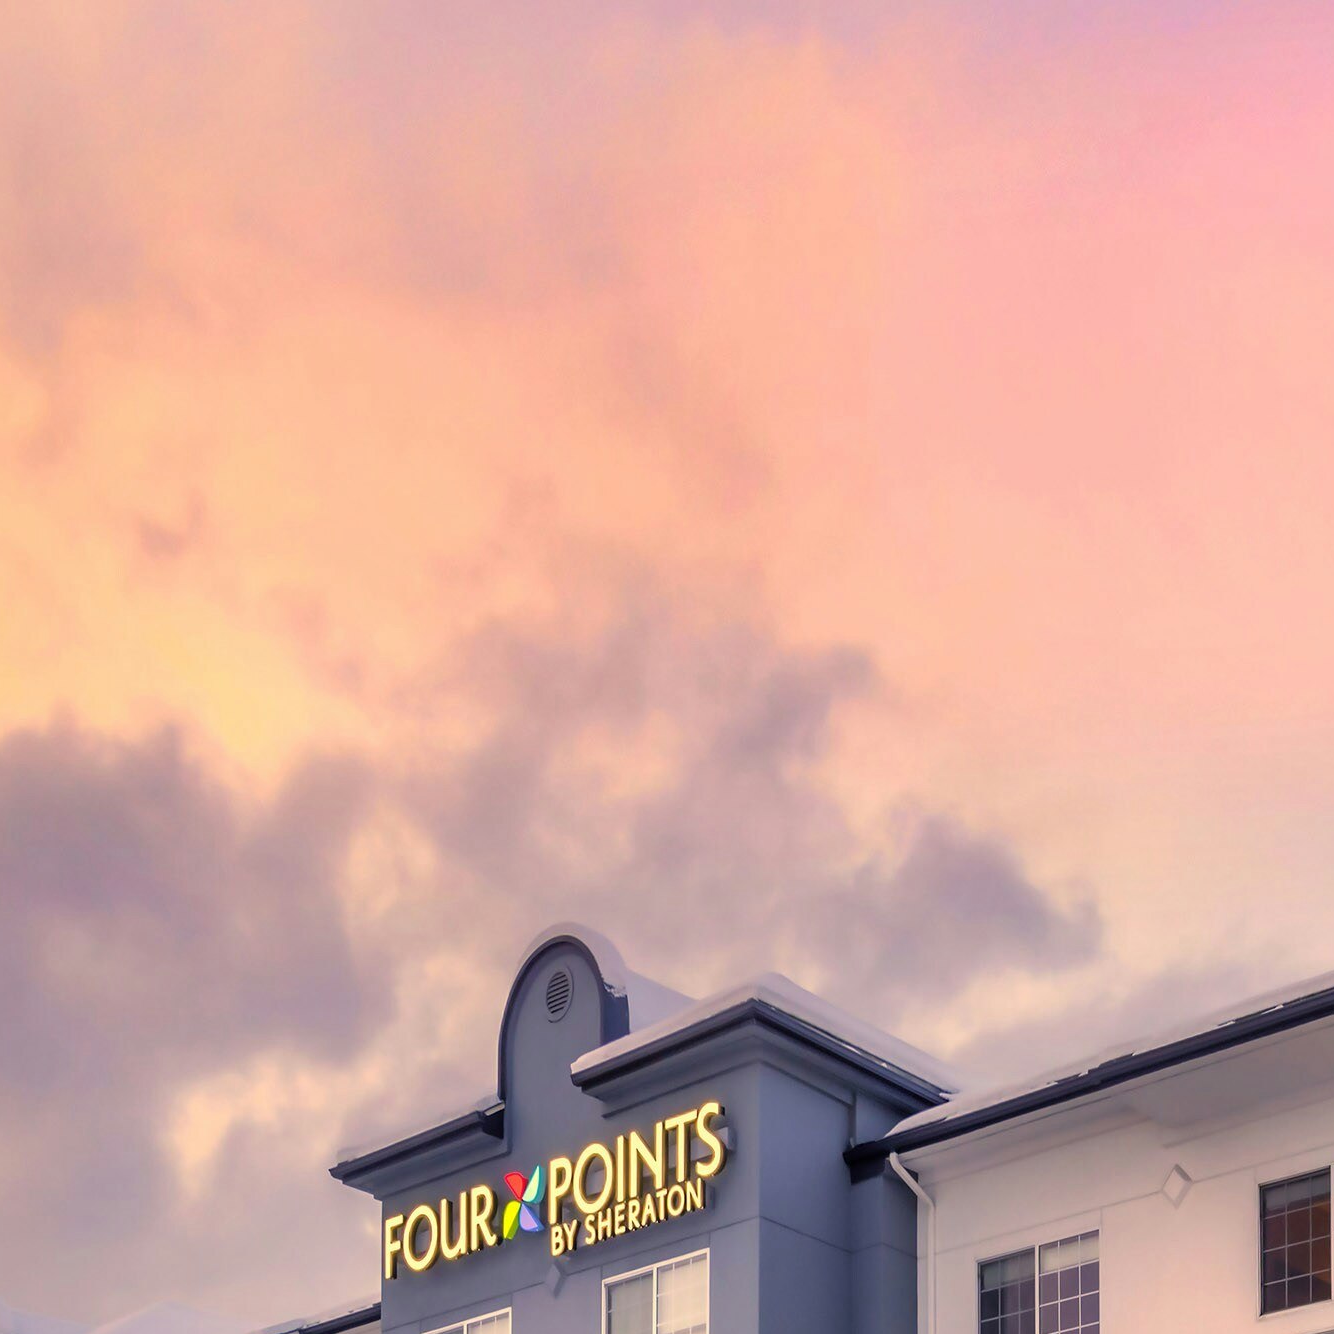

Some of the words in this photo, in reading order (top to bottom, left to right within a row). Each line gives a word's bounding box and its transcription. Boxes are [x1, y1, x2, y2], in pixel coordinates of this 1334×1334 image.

[383, 1184, 498, 1279] FOUR
[548, 1102, 728, 1225] POINTS
[550, 1219, 579, 1257] BY
[584, 1178, 706, 1246] SHERATON
